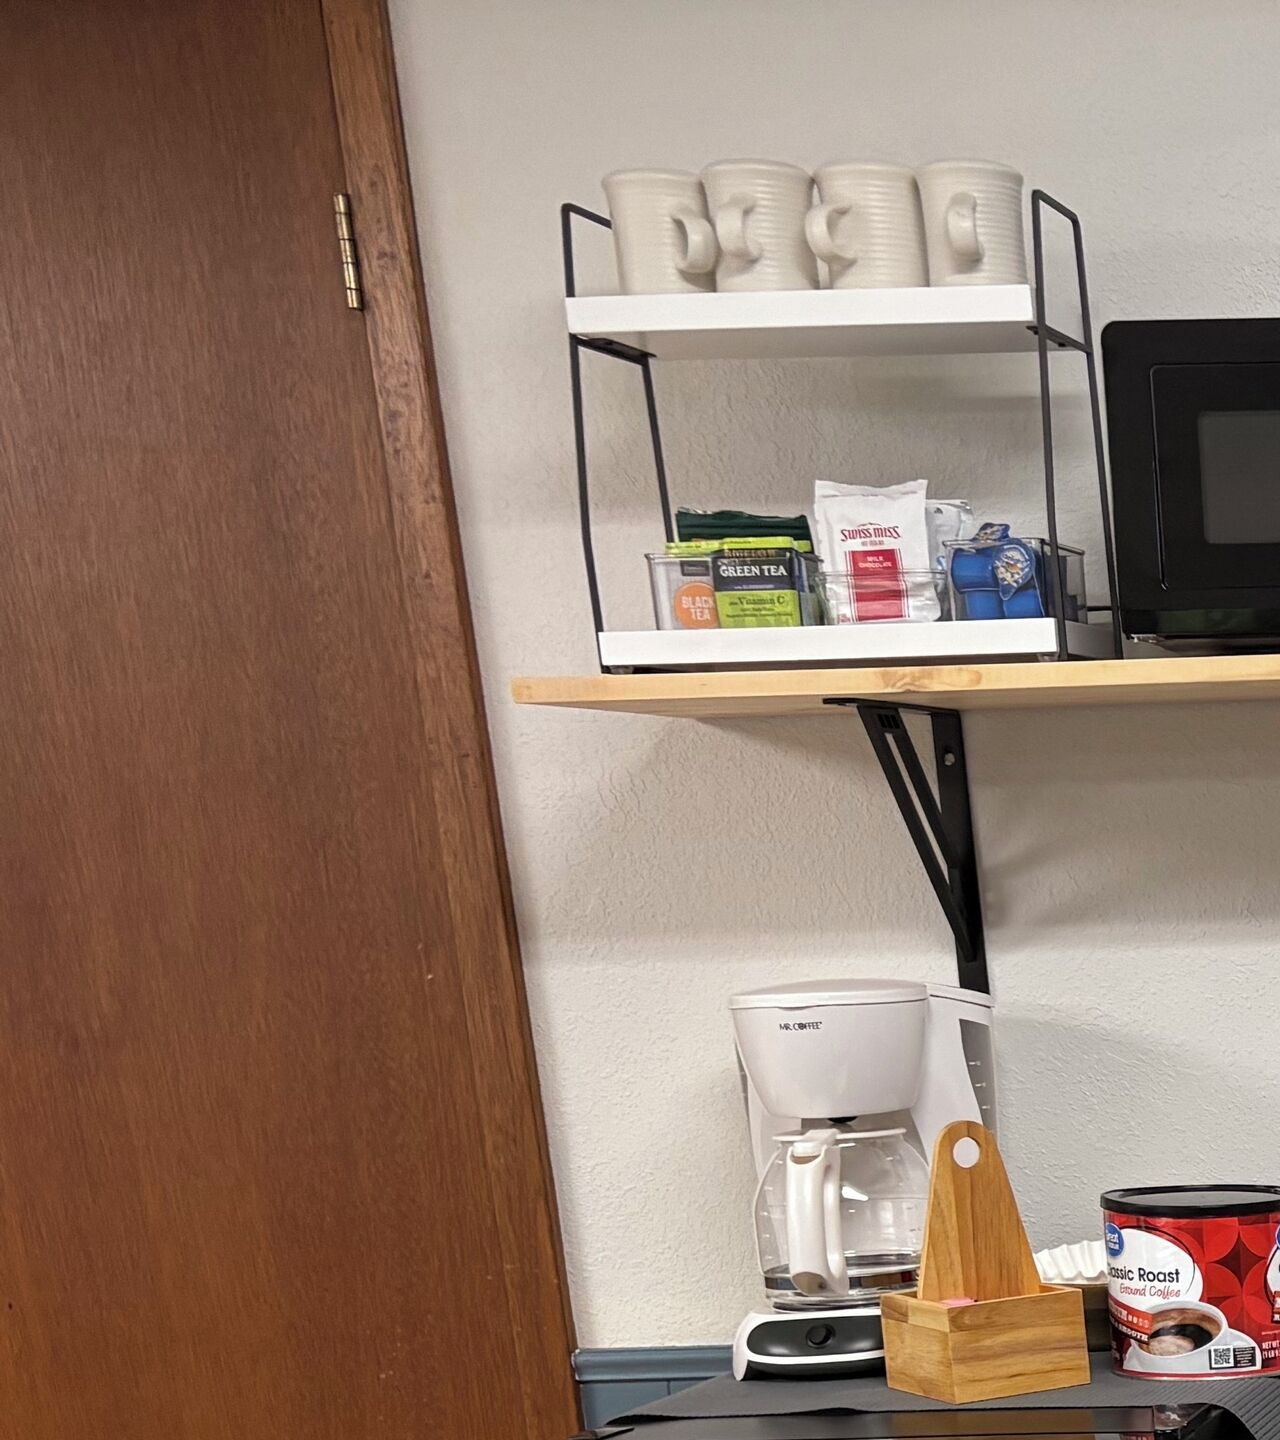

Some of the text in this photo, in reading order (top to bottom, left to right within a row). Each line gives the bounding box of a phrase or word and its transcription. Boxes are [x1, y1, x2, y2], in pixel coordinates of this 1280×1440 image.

[720, 565, 760, 577] GREEN
[761, 564, 788, 576] TEA
[690, 608, 711, 621] TEA
[1138, 1267, 1180, 1283] Roast
[1120, 1283, 1181, 1299] Ground Coffee
